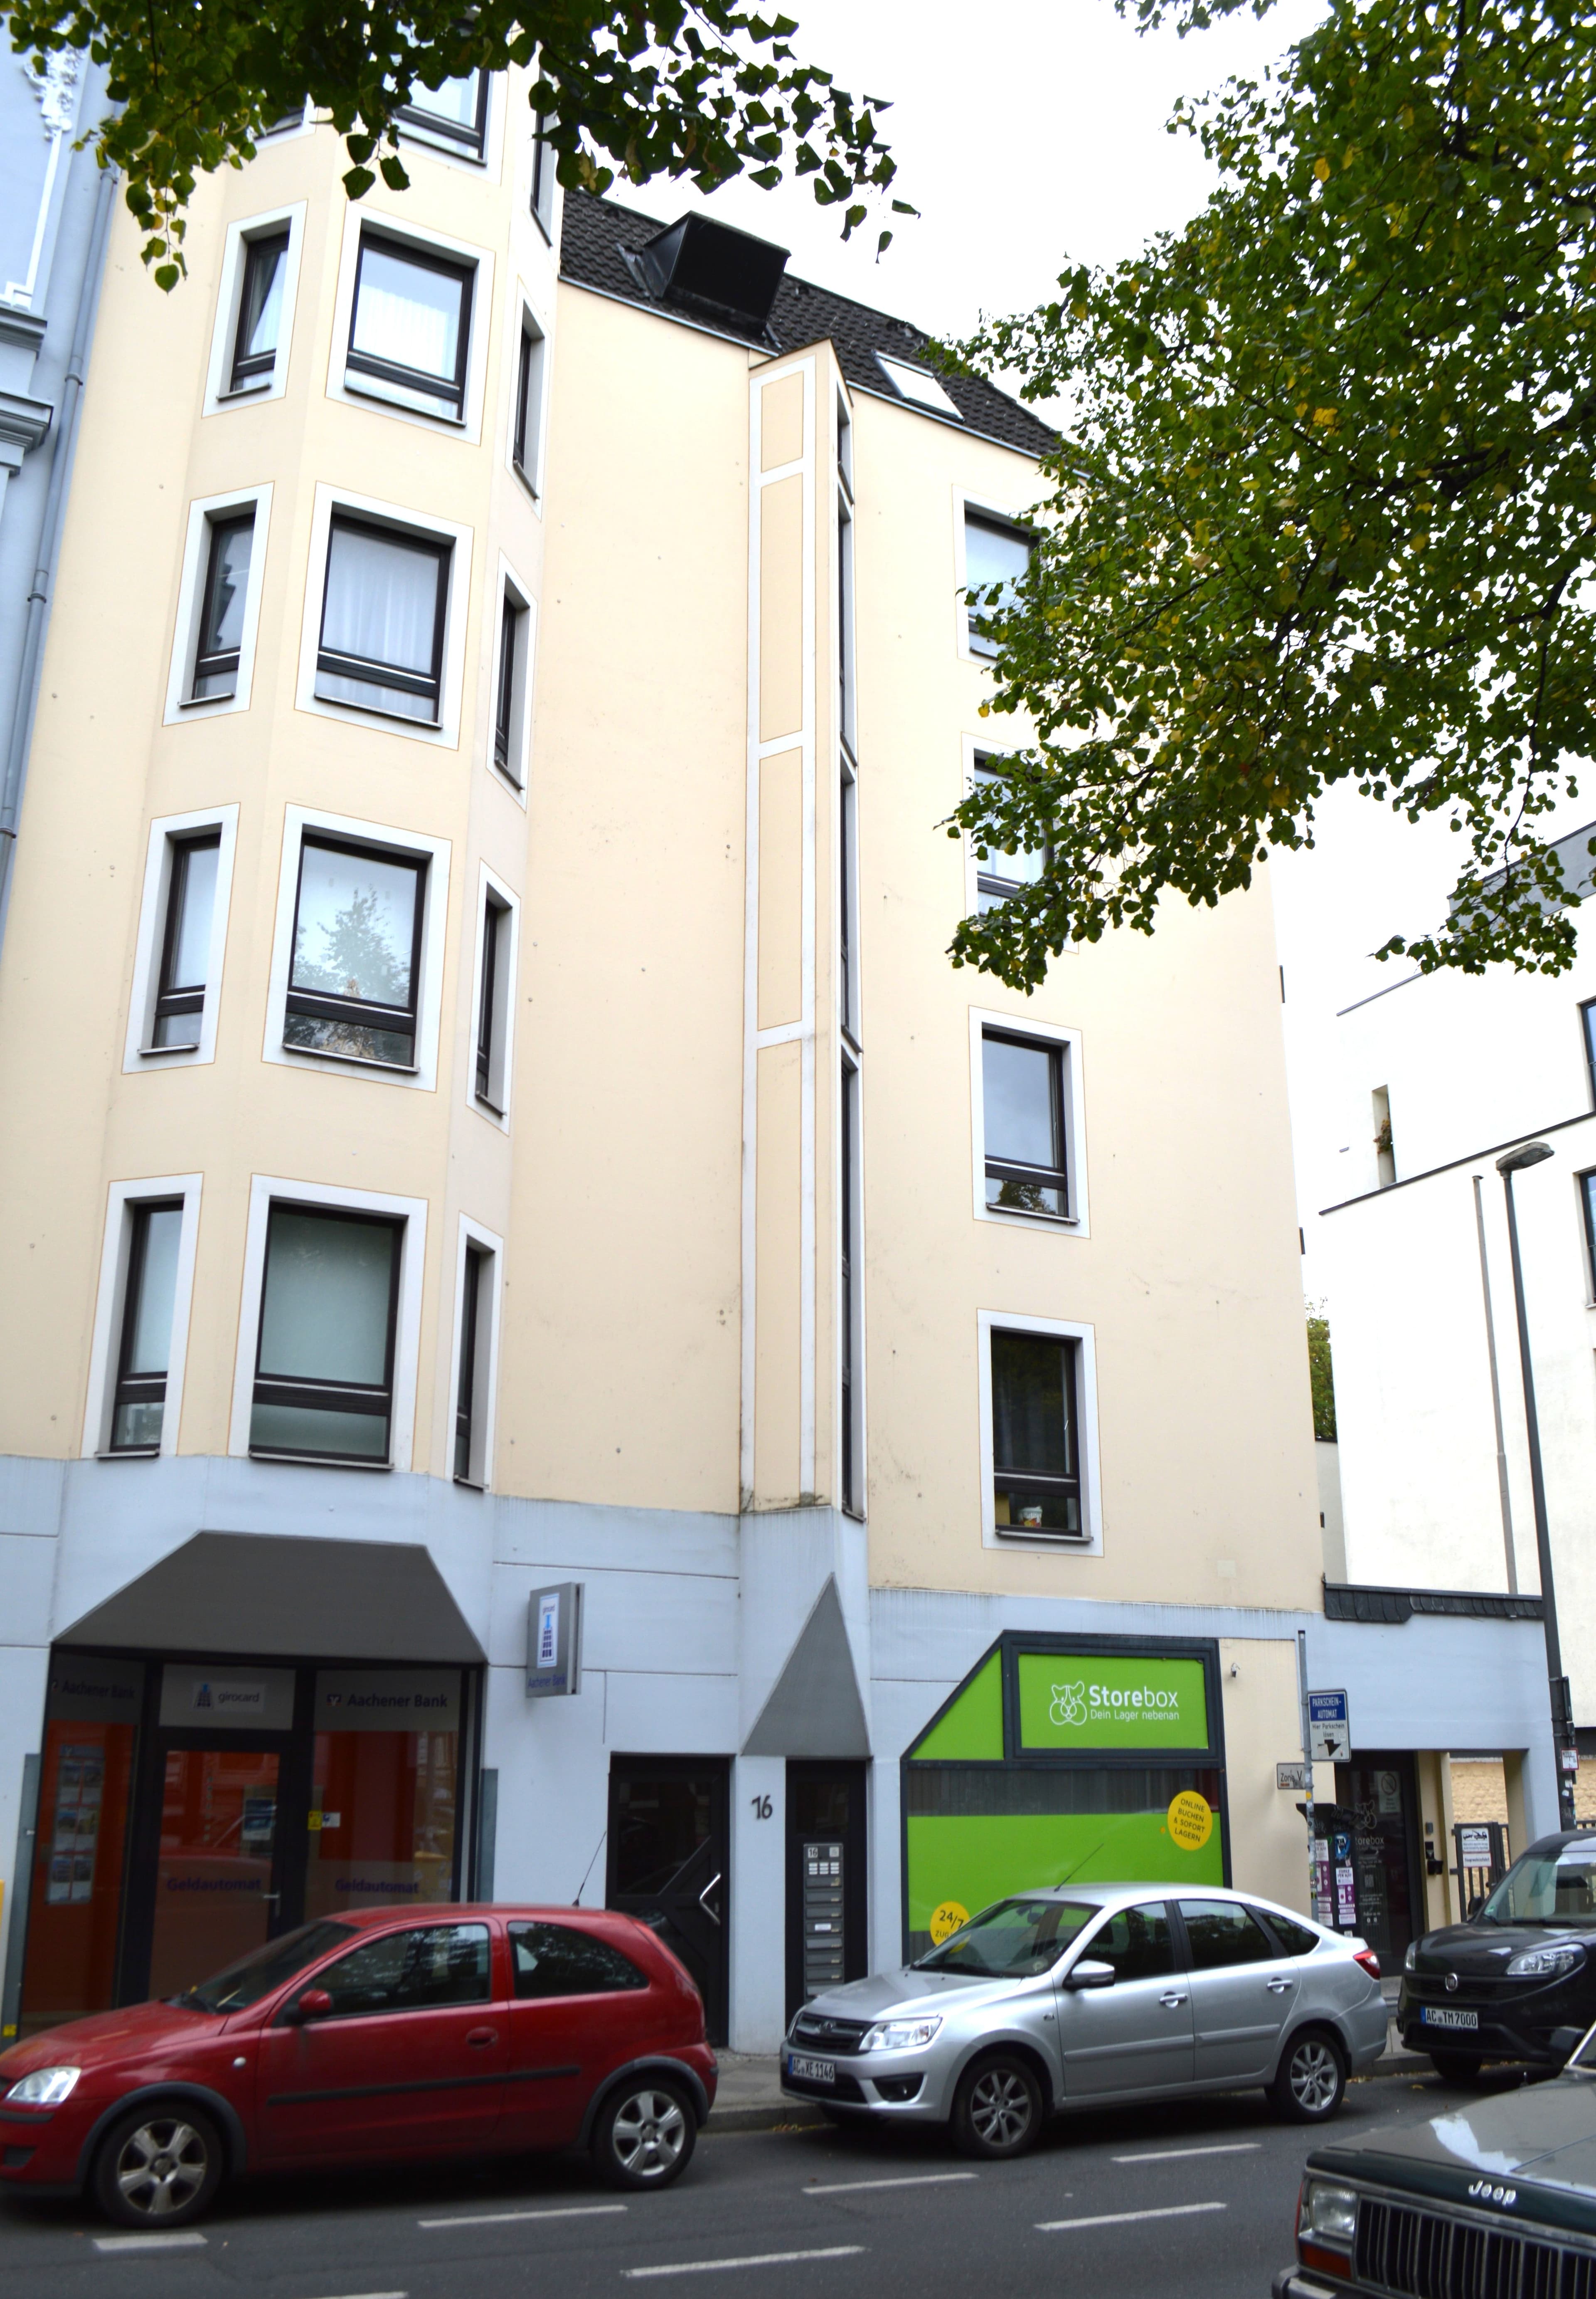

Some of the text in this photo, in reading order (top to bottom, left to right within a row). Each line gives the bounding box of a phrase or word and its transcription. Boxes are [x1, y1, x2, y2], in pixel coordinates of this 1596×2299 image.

[528, 1673, 566, 1688] Aachener Bank
[62, 1679, 135, 1699] Aachener Bank
[1089, 1685, 1179, 1708] Storebox
[218, 1690, 259, 1704] girocard
[347, 1693, 448, 1708] Aachener Bank
[1312, 1697, 1342, 1707] PARKSCHEIN-
[1091, 1709, 1180, 1722] Dein Lager nebenan
[1318, 1709, 1337, 1719] AUTOMAT
[1281, 1769, 1302, 1782] Zone V
[751, 1794, 773, 1819] 16
[1181, 1798, 1204, 1813] ONLINE
[1178, 1807, 1204, 1823] BUCHEN
[1180, 1819, 1205, 1833] SOFORT
[1175, 1827, 1201, 1843] LAGERN
[167, 1876, 261, 1891] Geldautomat
[335, 1878, 419, 1893] Geldautomat
[940, 1910, 964, 1929] 24/7
[1427, 2010, 1477, 2026] AC TM 7000
[793, 2059, 800, 2074] AC
[815, 2063, 833, 2080] 1146
[1468, 2180, 1516, 2206] Jeep
